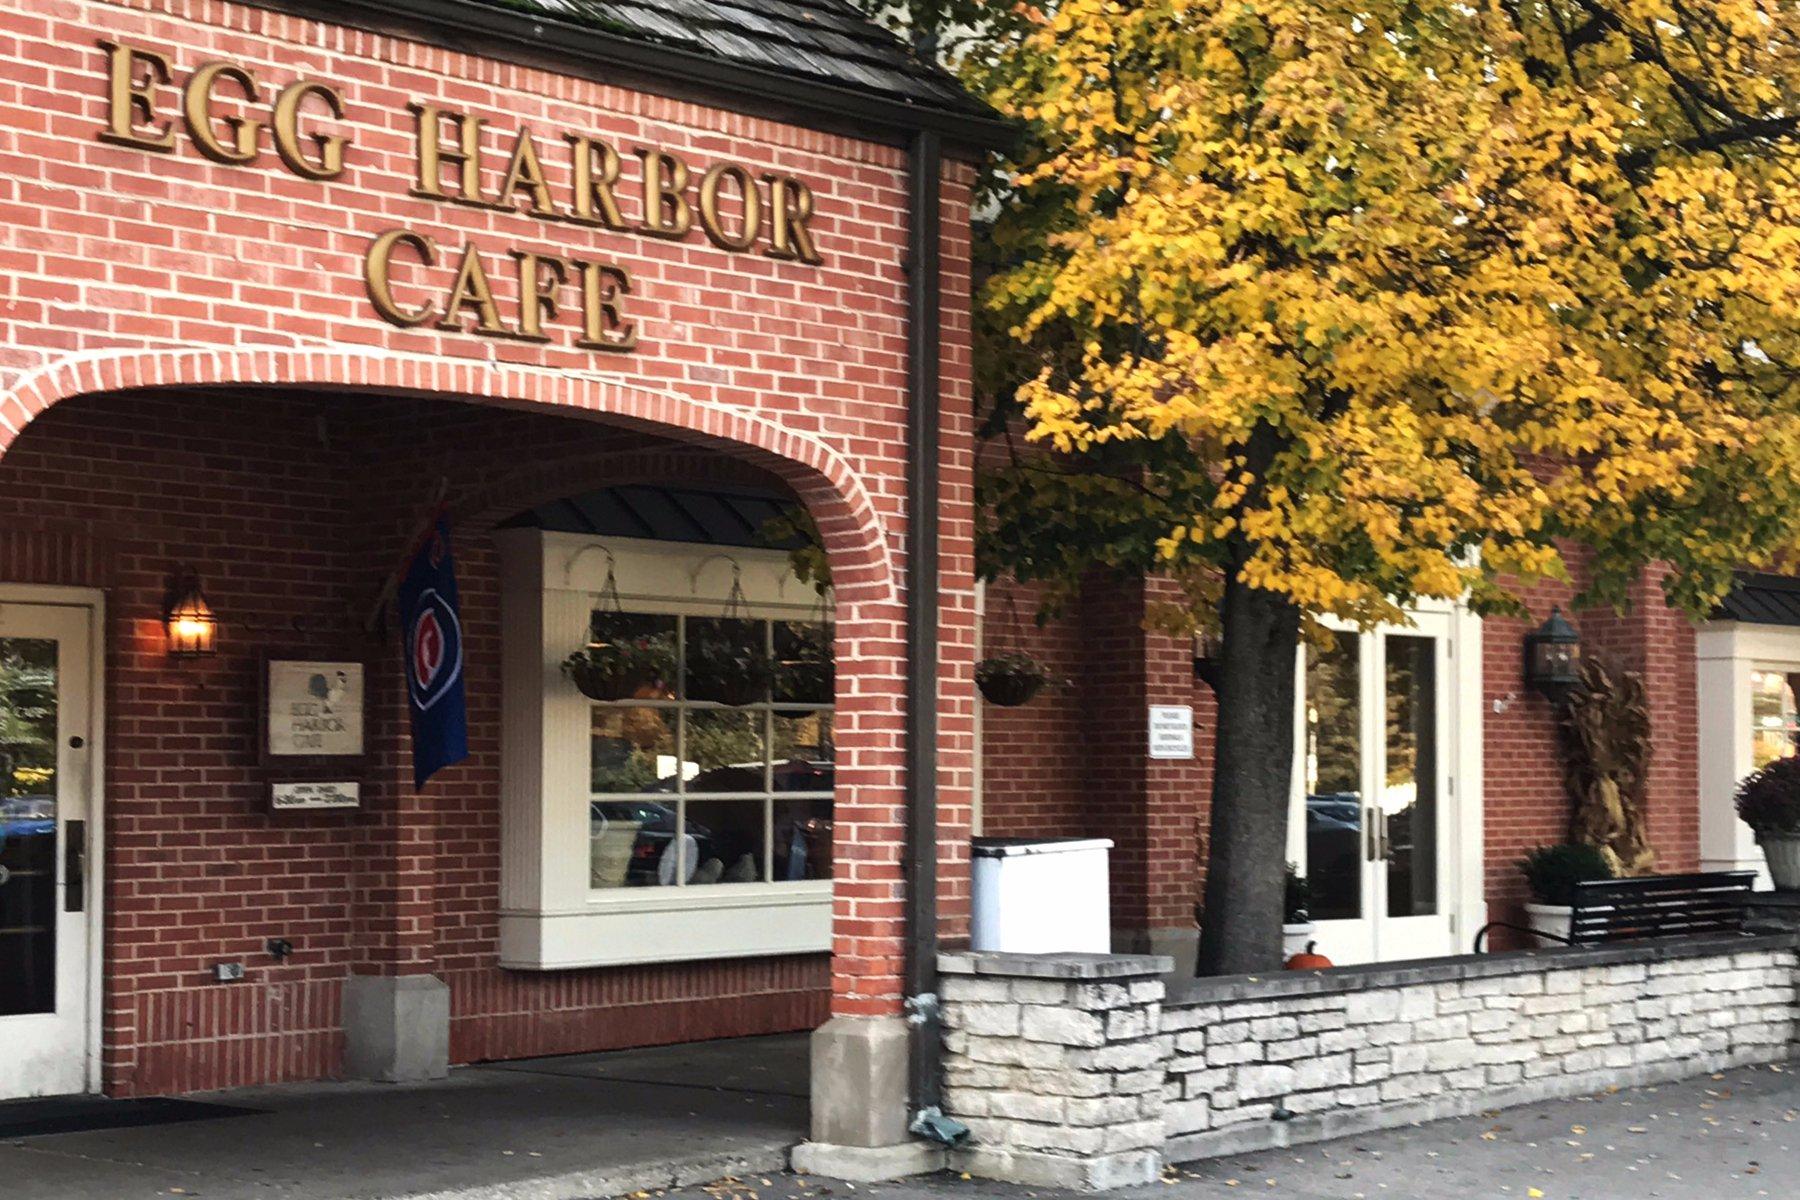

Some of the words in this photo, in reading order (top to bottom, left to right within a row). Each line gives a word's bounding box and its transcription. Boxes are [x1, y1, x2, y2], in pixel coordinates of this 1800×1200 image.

[96, 39, 352, 181] EGG
[406, 101, 825, 266] HARBOR
[365, 229, 639, 352] CAFE
